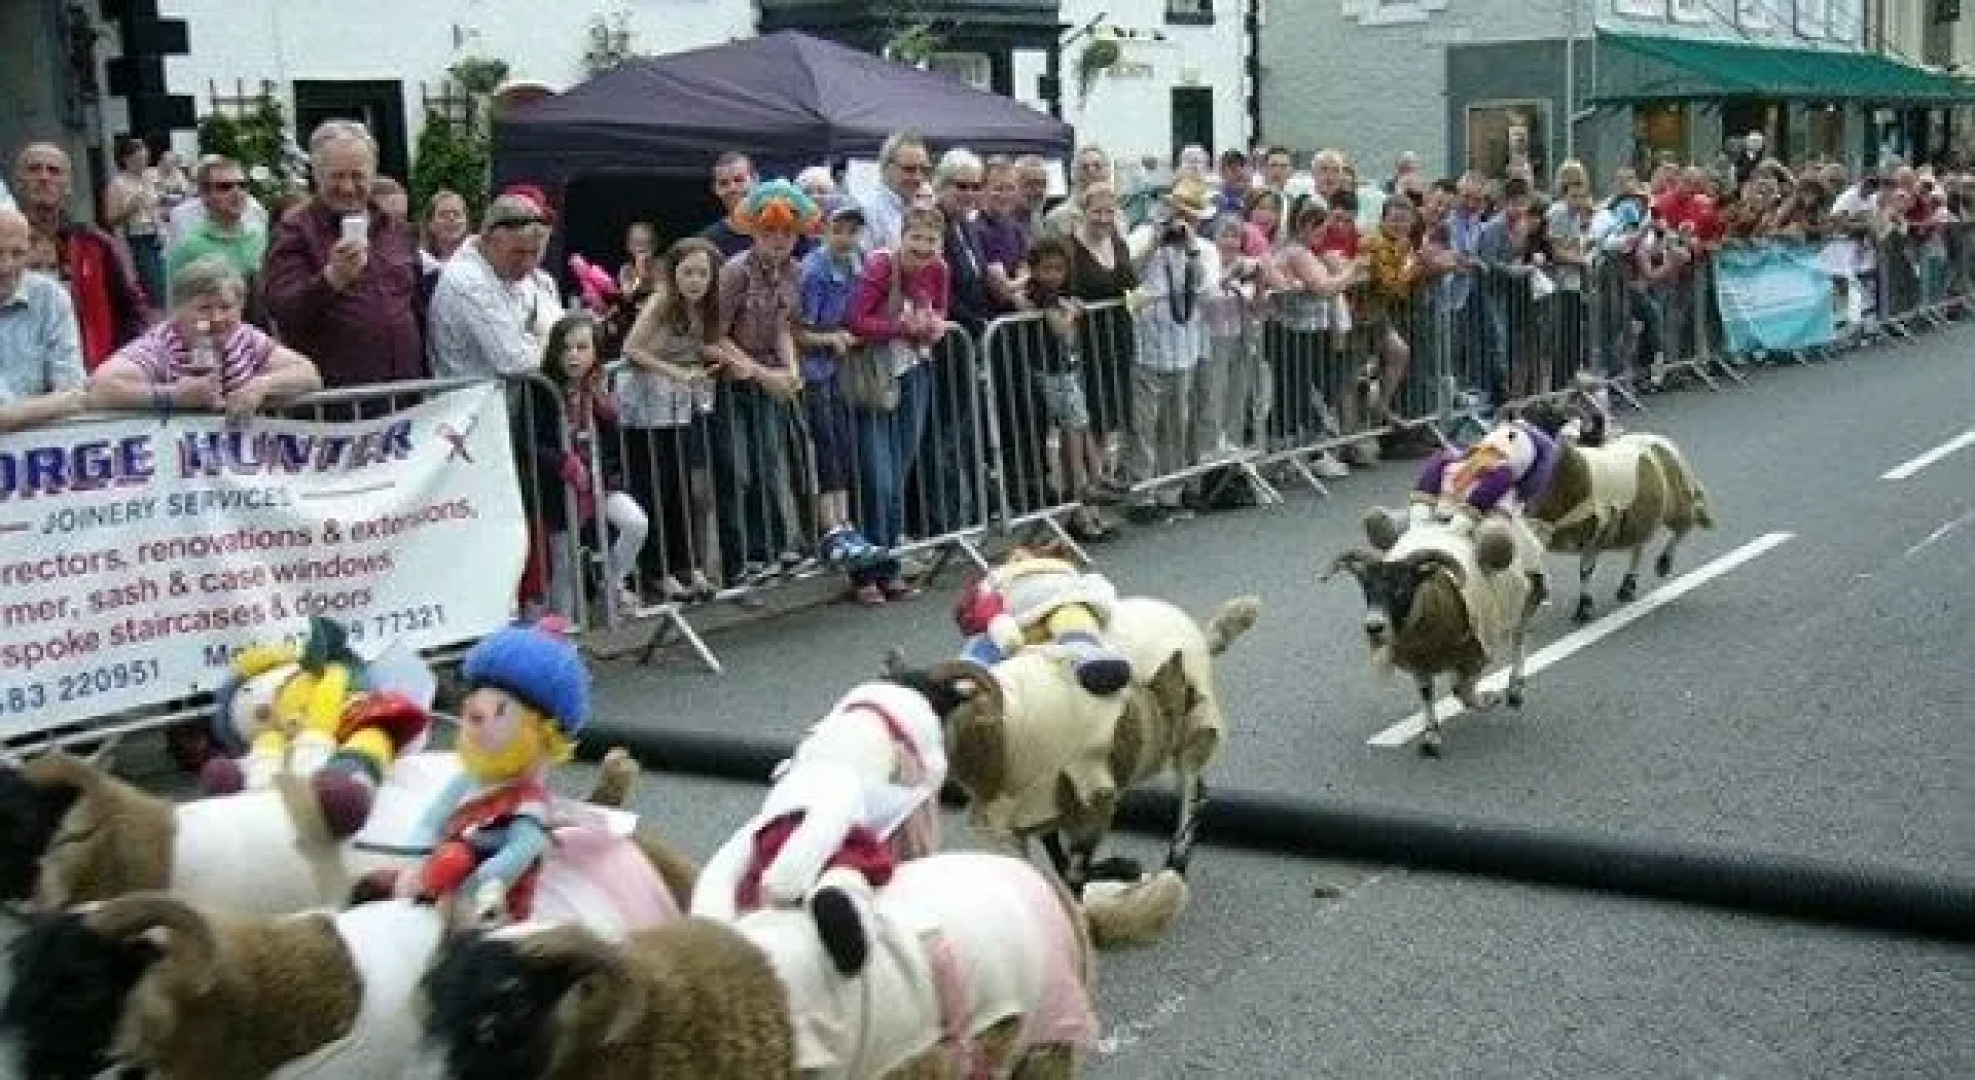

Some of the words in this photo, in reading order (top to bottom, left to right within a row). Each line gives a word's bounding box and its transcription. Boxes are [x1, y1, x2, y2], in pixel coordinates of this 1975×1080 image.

[175, 419, 414, 478] HUNTER
[43, 497, 157, 535] JOINERY
[138, 525, 313, 565] renovations
[323, 518, 341, 545] &
[88, 577, 159, 613] sash
[169, 570, 188, 596] &
[200, 564, 267, 593] case
[271, 551, 395, 583] windows
[2, 629, 100, 670] spoke
[110, 605, 267, 646] staircases
[296, 586, 372, 615] doors
[0, 683, 46, 714] 83
[58, 658, 159, 701] 220951
